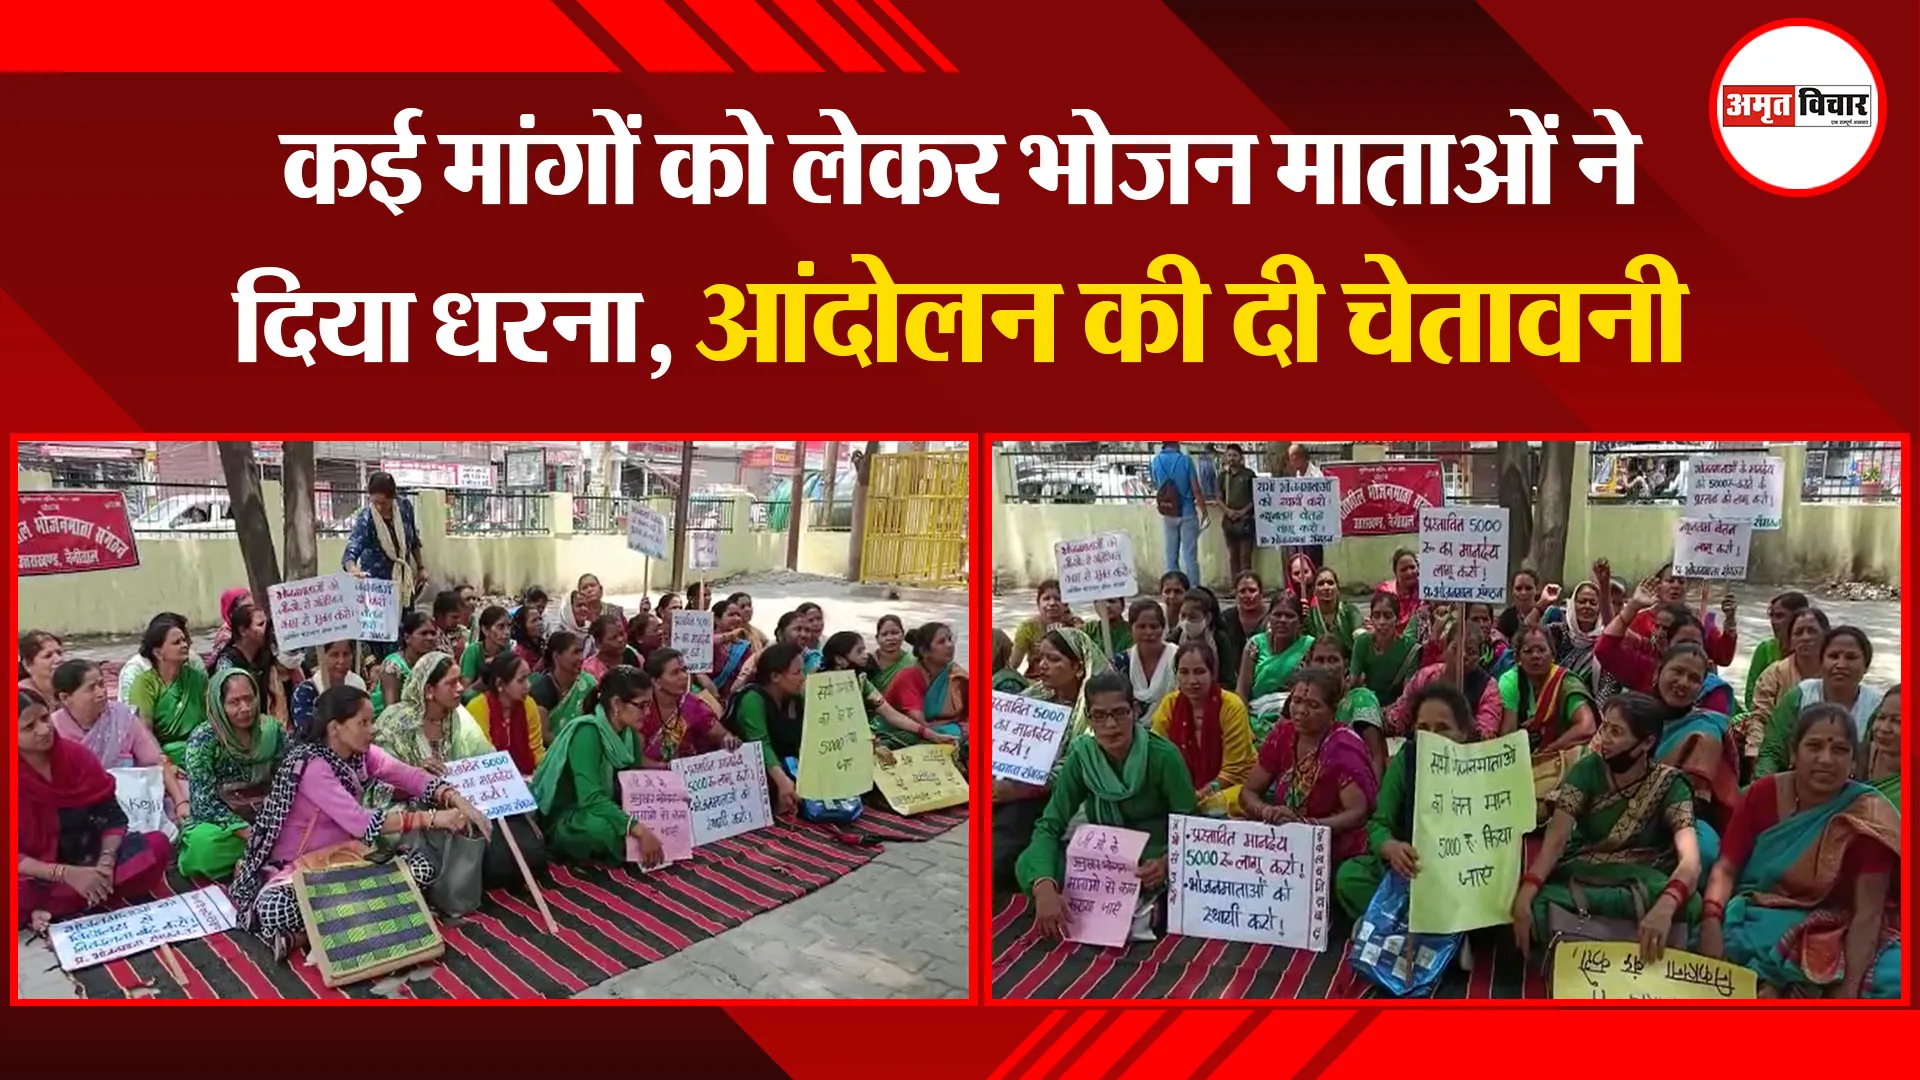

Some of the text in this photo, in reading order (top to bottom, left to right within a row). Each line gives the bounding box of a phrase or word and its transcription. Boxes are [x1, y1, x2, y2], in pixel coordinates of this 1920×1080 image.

[33, 511, 94, 540] भोजनमाता
[95, 525, 129, 560] संगठन
[1423, 512, 1503, 533] प्रस्तावित 5000
[1440, 541, 1453, 557] का
[1459, 536, 1502, 561] मानदेय
[1433, 564, 1455, 581] लागू
[1032, 706, 1064, 723] 5000
[482, 756, 509, 769] 5000
[1484, 789, 1512, 812] मान
[1191, 824, 1289, 852] प्रस्तावित मानदेय
[1438, 836, 1462, 860] 5000
[1482, 823, 1514, 851] किया
[1186, 850, 1218, 867] 5000
[1236, 855, 1265, 876] लागू
[1188, 870, 1295, 902] भोजनमाताओं को
[1203, 902, 1245, 928] स्थायी
[1621, 953, 1645, 980] बंद
[1665, 959, 1735, 997] निकालना
